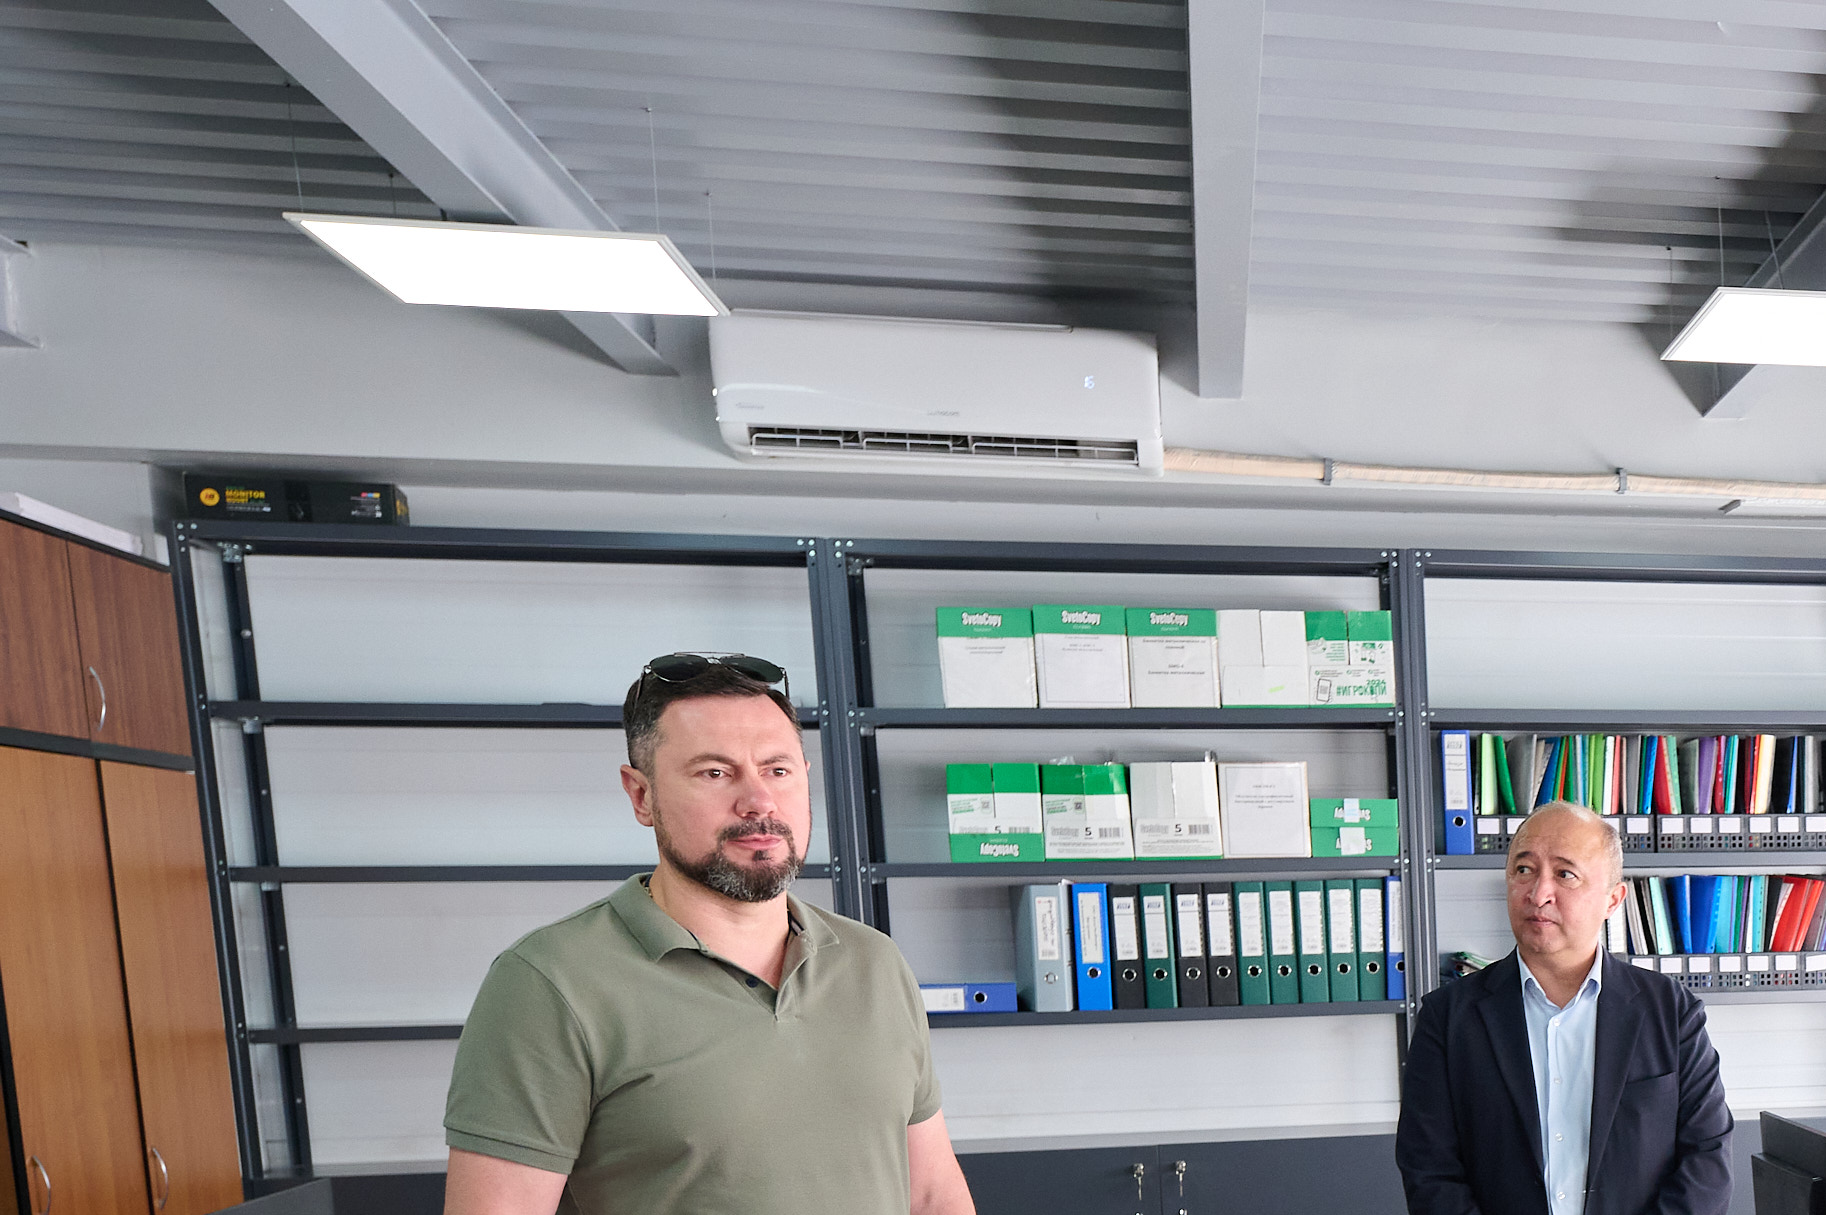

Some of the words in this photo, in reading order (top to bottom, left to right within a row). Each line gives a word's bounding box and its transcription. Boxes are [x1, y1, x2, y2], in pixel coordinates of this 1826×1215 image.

[962, 612, 1002, 627] SvetoCopy
[1061, 610, 1101, 625] SvetoCopy
[1150, 612, 1188, 626] SvetoCopy
[1085, 827, 1092, 836] 5
[1175, 824, 1181, 833] 5
[980, 842, 1019, 857] SvetoCopy
